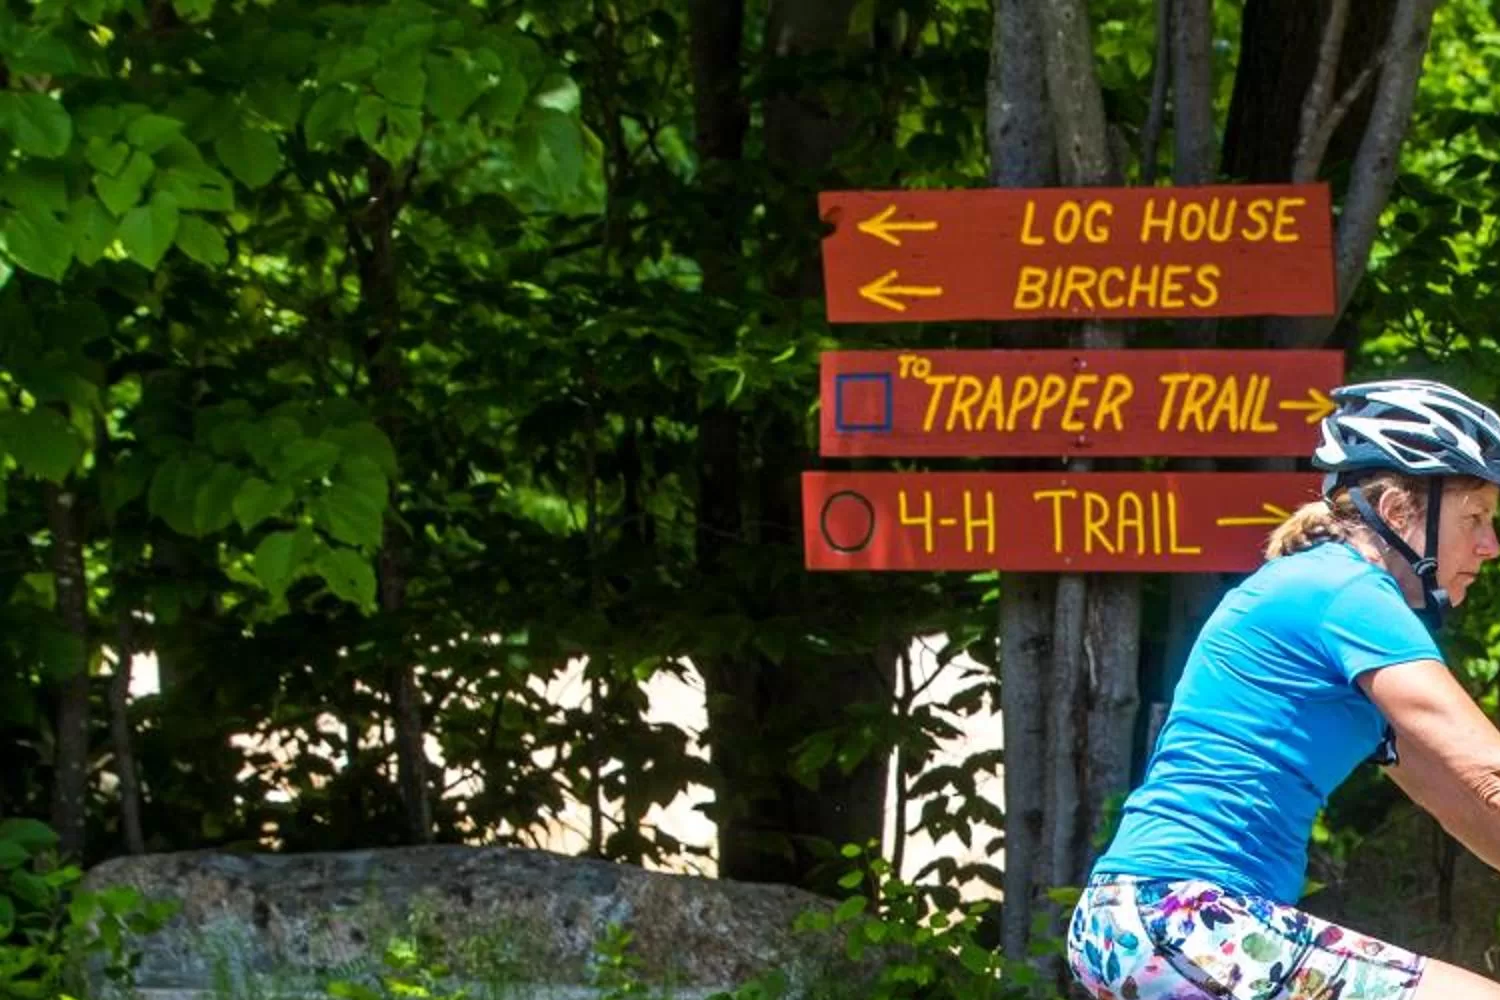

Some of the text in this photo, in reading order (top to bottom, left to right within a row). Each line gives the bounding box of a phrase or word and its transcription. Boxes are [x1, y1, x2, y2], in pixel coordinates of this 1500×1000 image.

[1020, 196, 1306, 246] LOG HOUSE
[1013, 263, 1222, 311] BIRCHES
[921, 372, 1279, 433] TRAPPER TRAIL
[898, 489, 1202, 555] 4-H TRAIL
